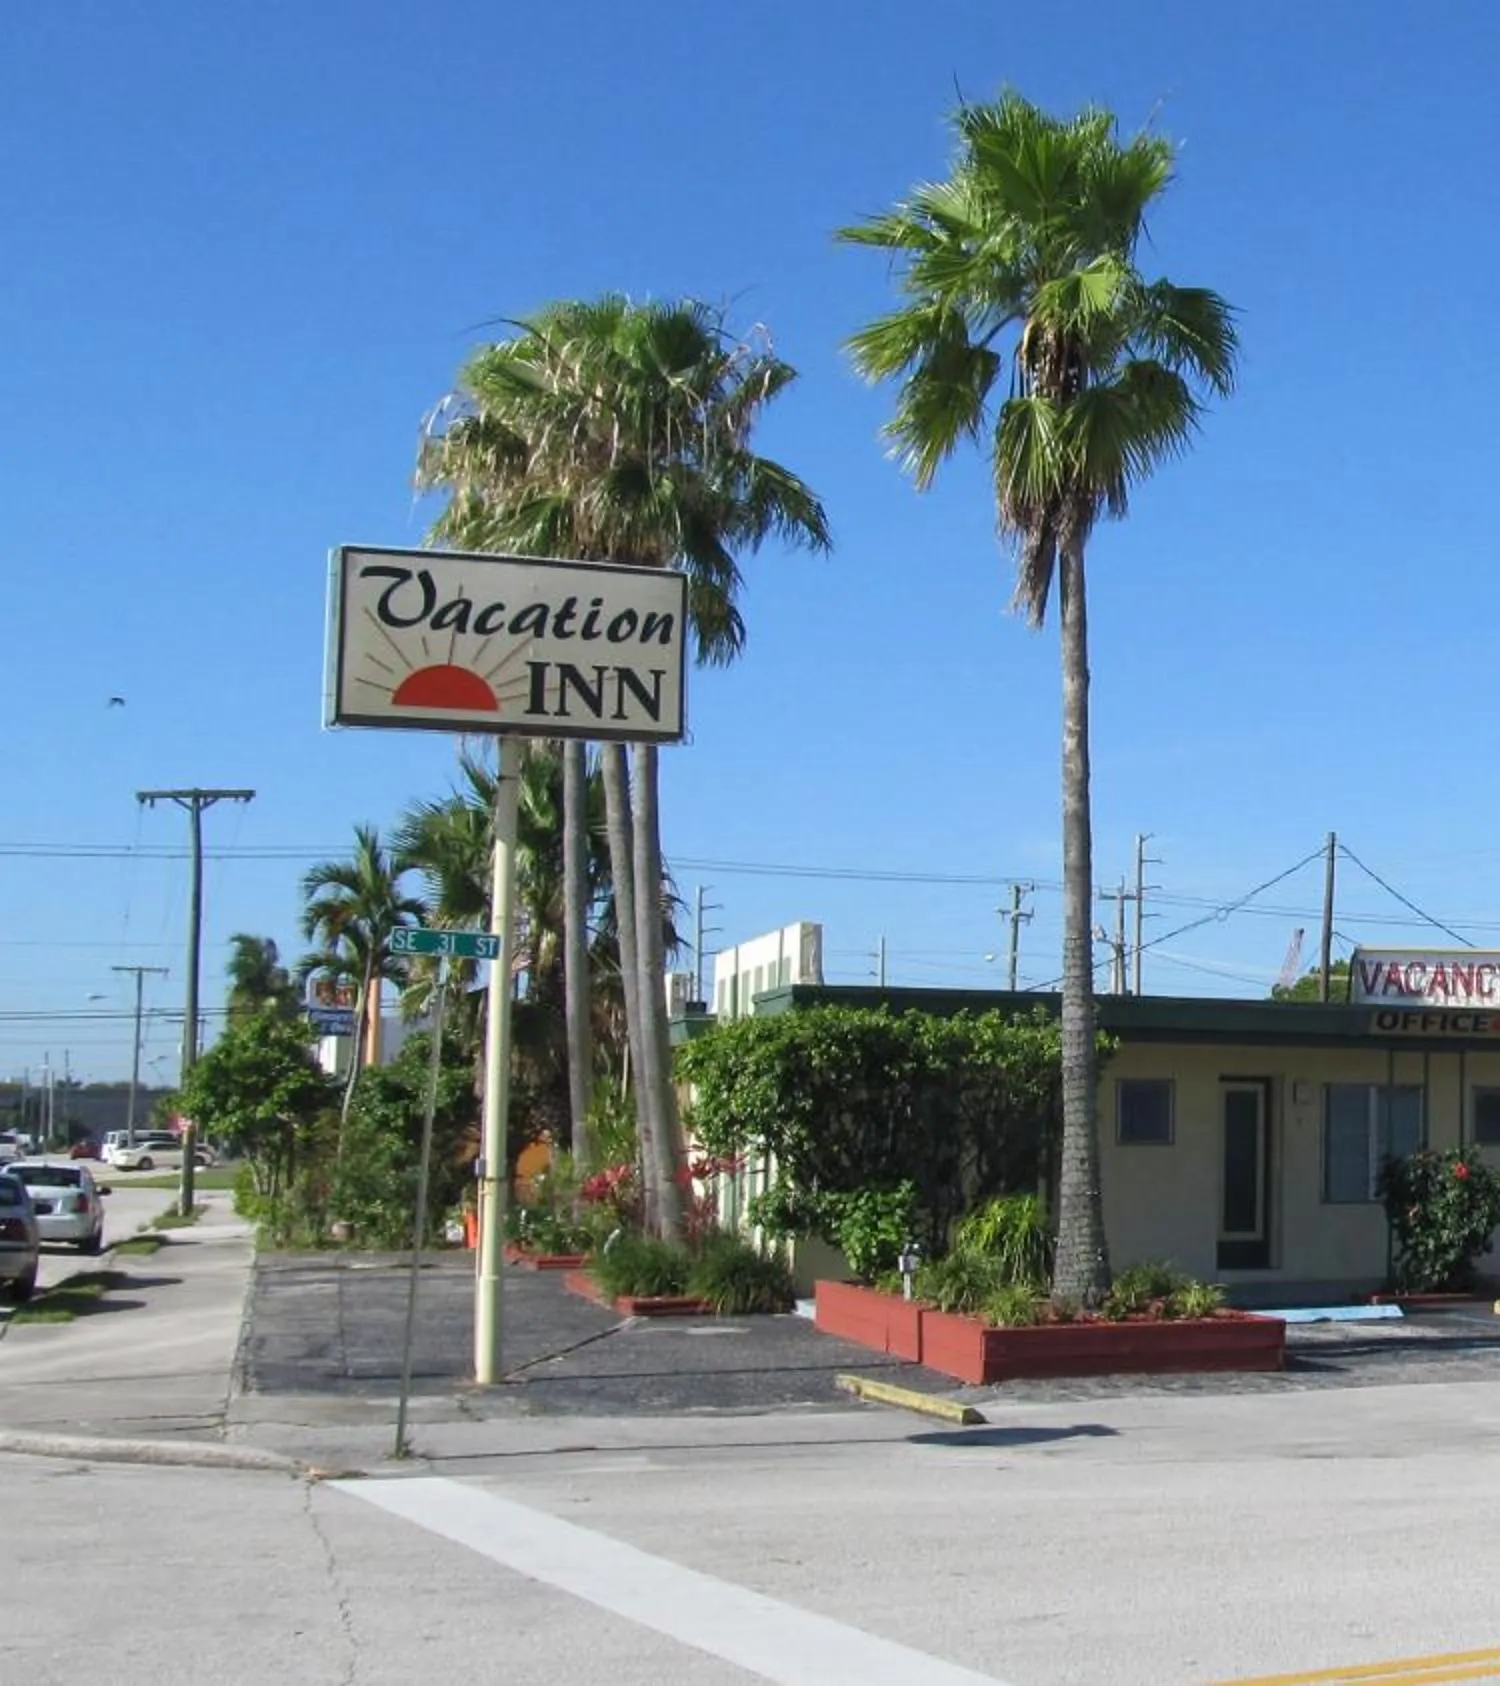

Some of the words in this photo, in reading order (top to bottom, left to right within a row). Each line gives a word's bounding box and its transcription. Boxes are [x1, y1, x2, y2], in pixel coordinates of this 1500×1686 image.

[360, 565, 675, 645] Vacation
[523, 660, 667, 722] INN
[394, 930, 417, 950] SE
[437, 934, 456, 954] 31
[475, 937, 497, 956] ST
[1376, 1010, 1489, 1033] OFFICE
